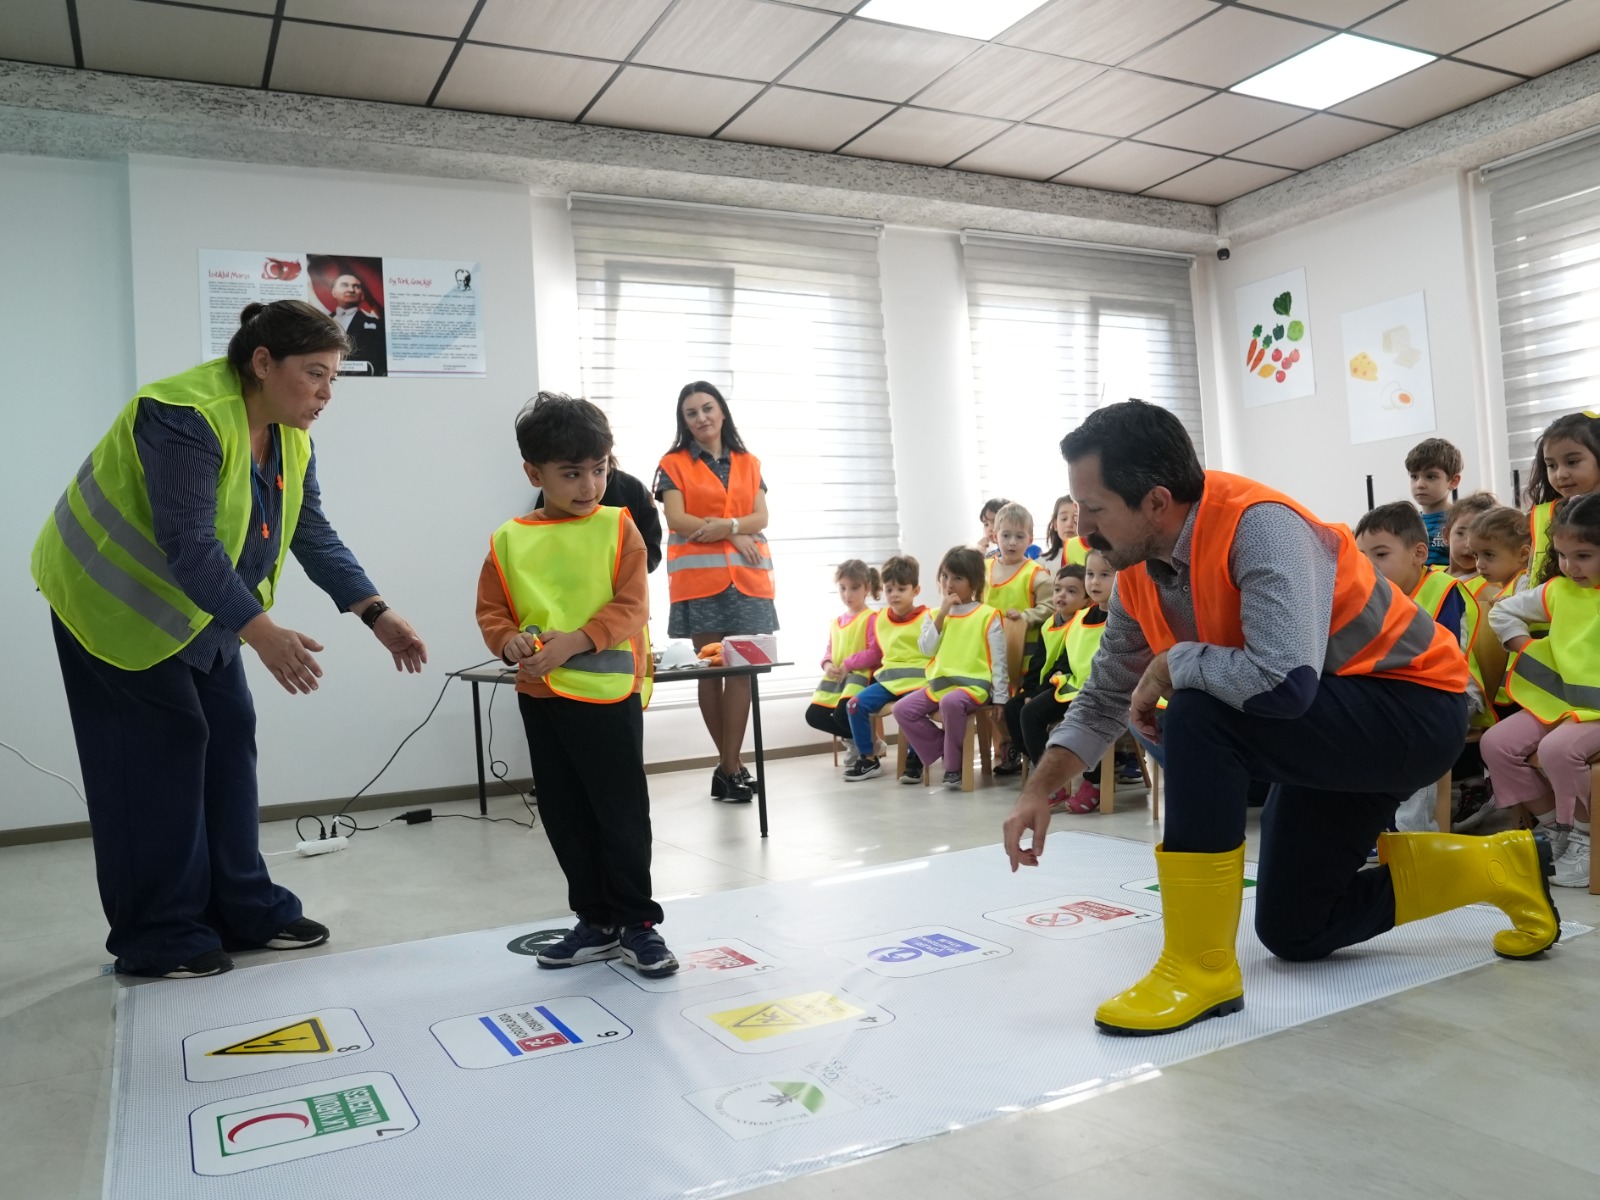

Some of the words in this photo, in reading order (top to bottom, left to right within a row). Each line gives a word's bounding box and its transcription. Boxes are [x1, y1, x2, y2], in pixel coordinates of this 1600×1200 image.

[754, 964, 775, 972] 5
[597, 1030, 619, 1039] 6
[337, 1044, 361, 1053] 8
[312, 1094, 345, 1121] YARDIM
[337, 1086, 382, 1126] MALZEMESİ
[317, 1116, 349, 1134] İLK
[376, 1127, 405, 1136] 7
